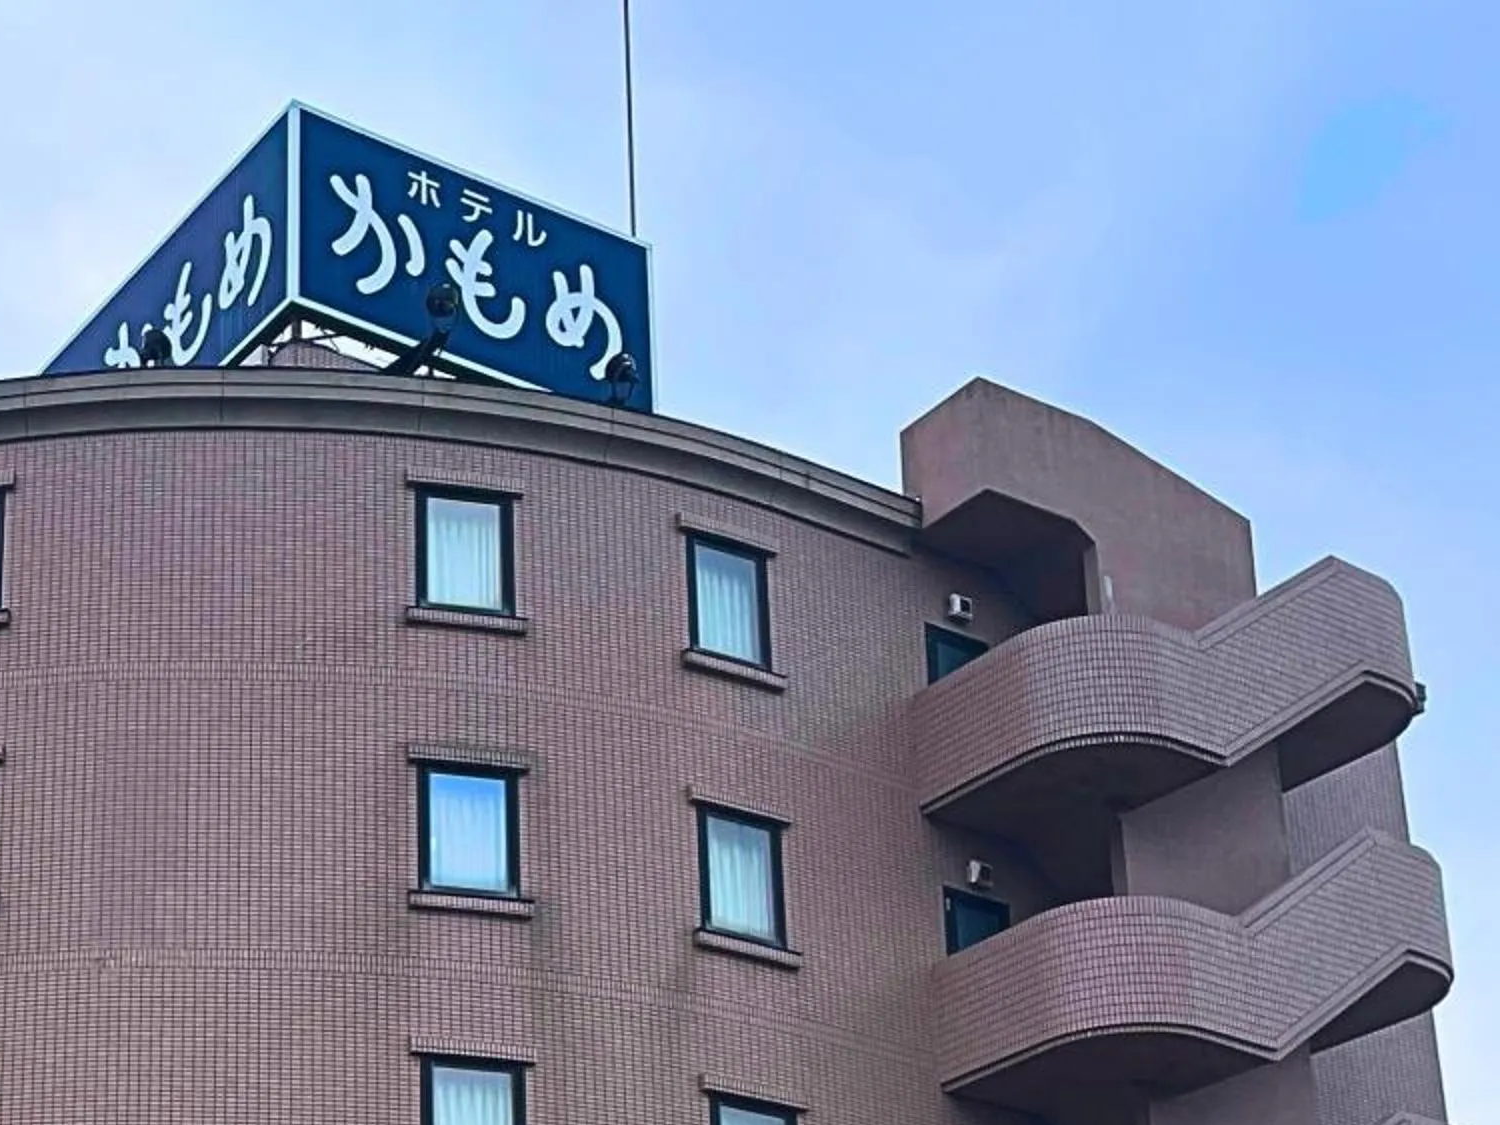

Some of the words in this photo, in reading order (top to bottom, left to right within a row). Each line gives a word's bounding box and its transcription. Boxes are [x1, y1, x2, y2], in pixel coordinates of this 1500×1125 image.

[330, 173, 624, 382] かもめ
[408, 170, 547, 248] ホテル
